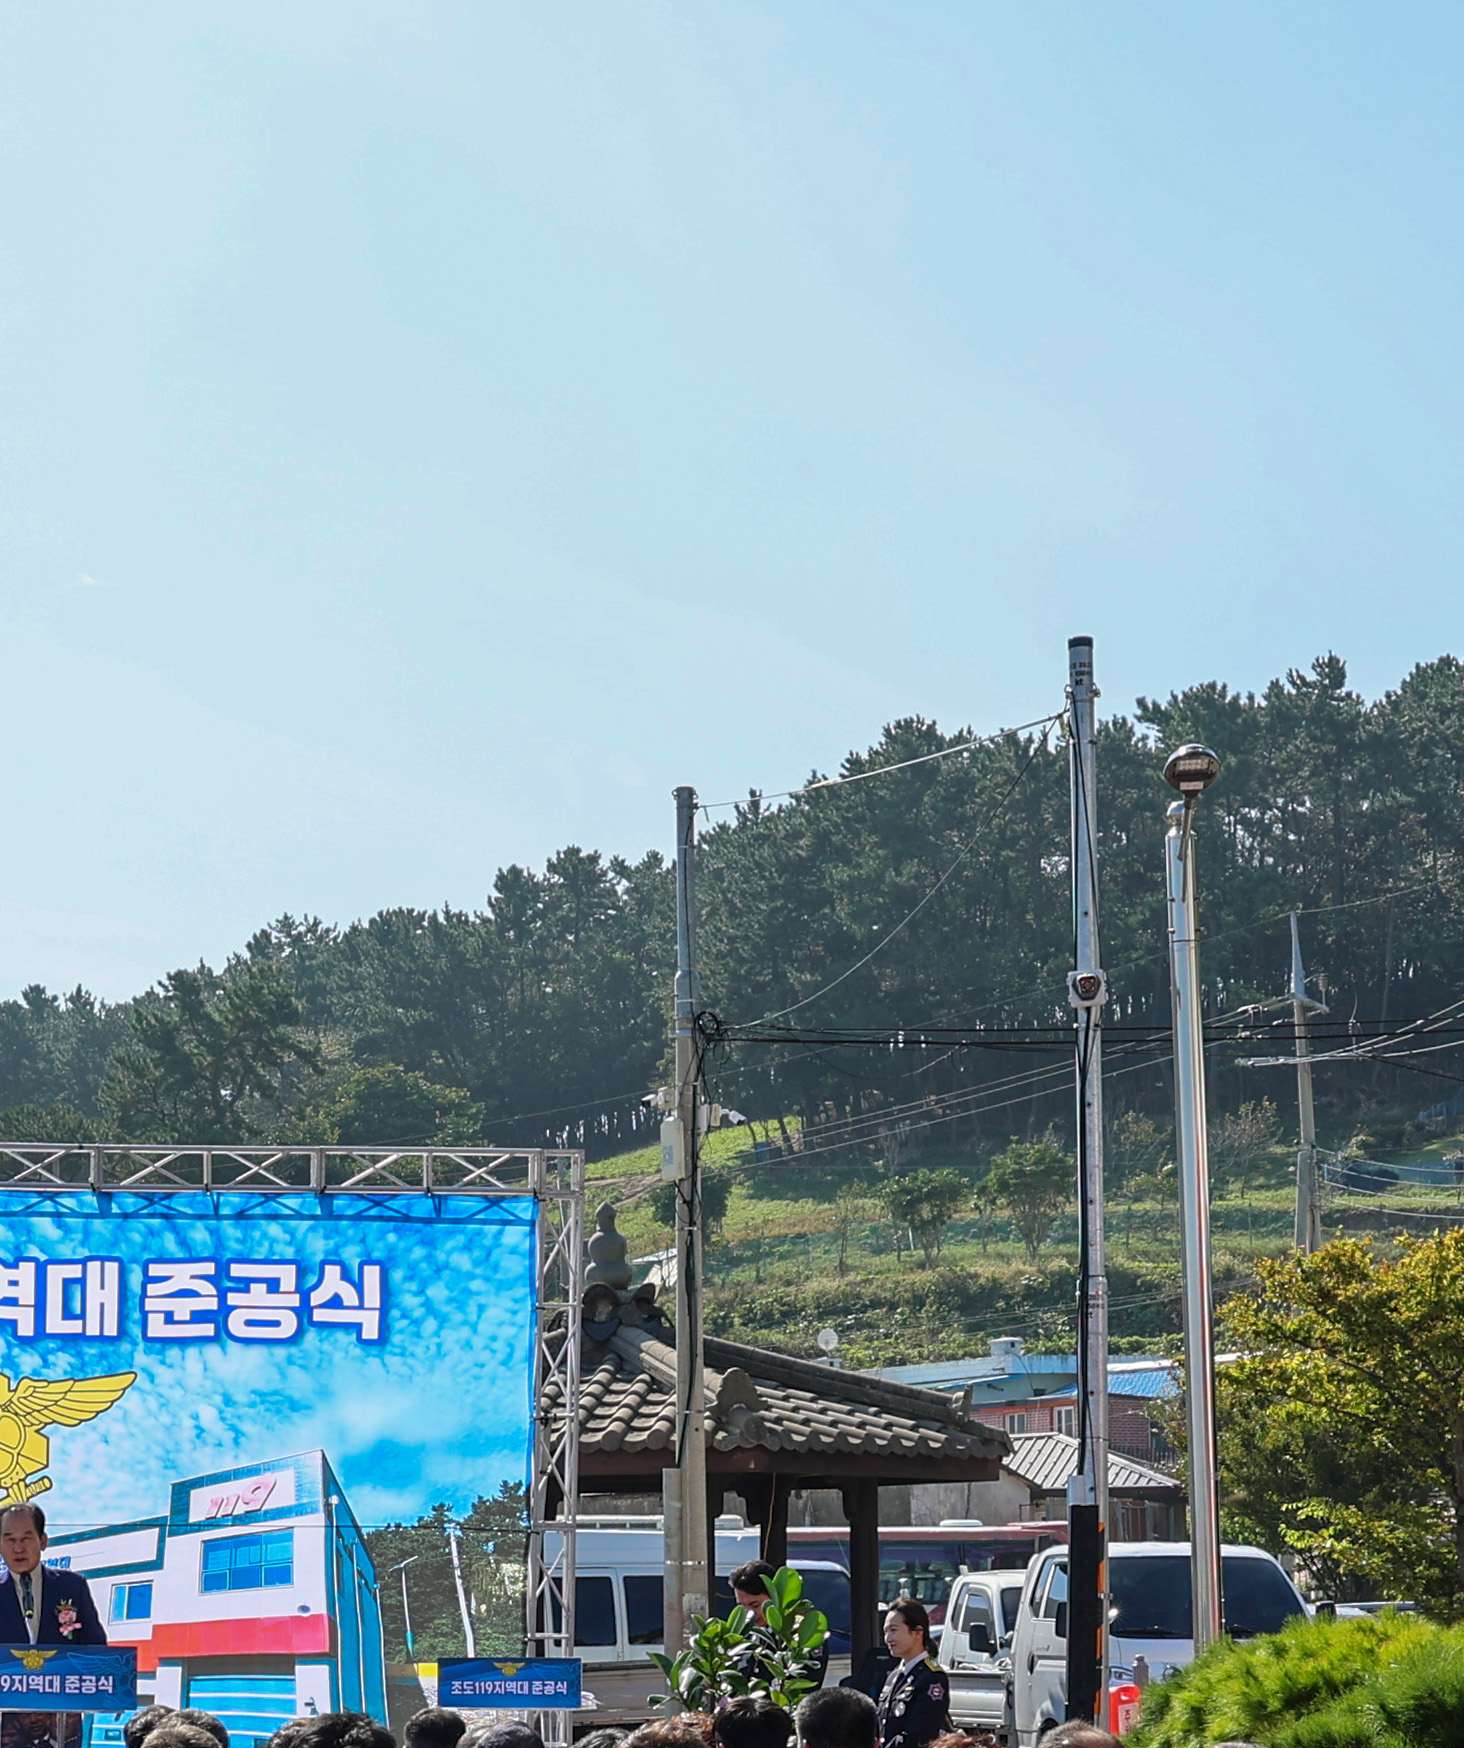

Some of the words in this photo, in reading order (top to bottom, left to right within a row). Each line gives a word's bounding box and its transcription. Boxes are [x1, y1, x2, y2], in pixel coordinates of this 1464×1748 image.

[143, 1259, 382, 1340] 준공식
[64, 1674, 114, 1694] 준공식
[450, 1680, 529, 1696] 조도119지역대
[531, 1680, 568, 1696] 준공식
